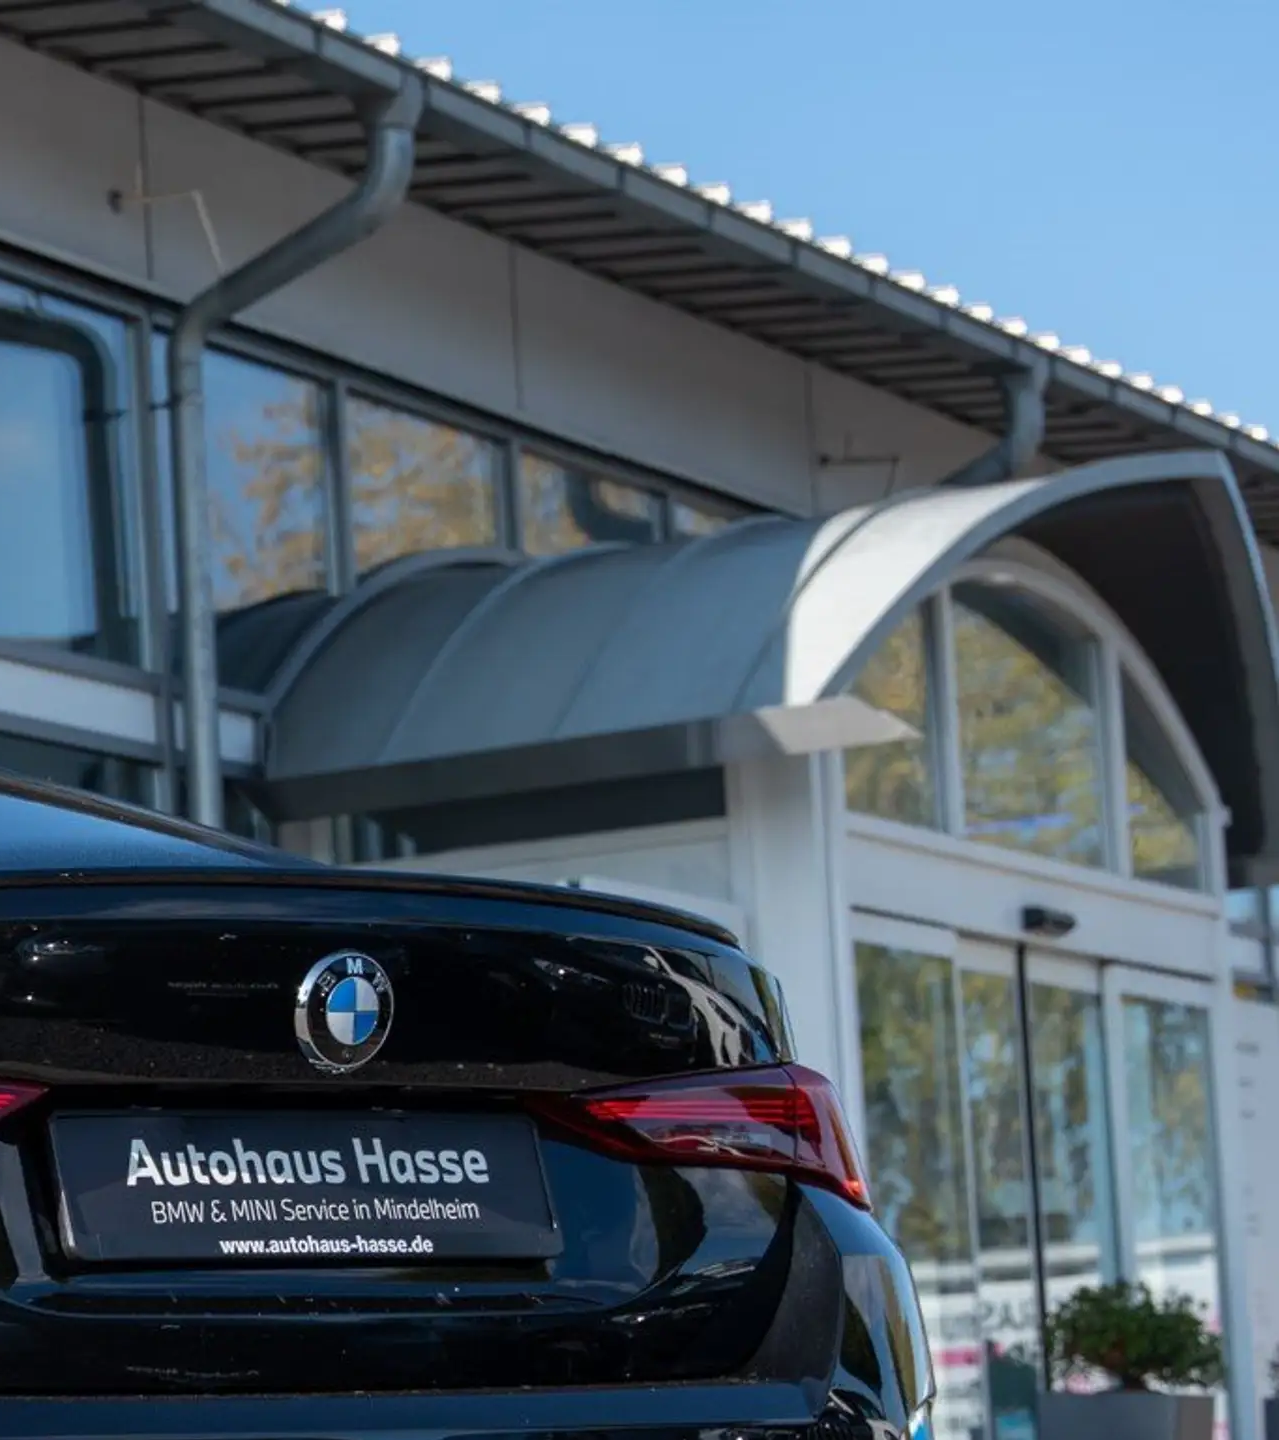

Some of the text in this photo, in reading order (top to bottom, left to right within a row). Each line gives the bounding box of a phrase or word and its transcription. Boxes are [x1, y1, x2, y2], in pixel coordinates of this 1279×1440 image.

[126, 1137, 490, 1187] Autohaus Hasse
[151, 1197, 480, 1224] BMW & MINI Service in Mindelheim
[219, 1235, 434, 1255] www.autohaus-hasse.de
